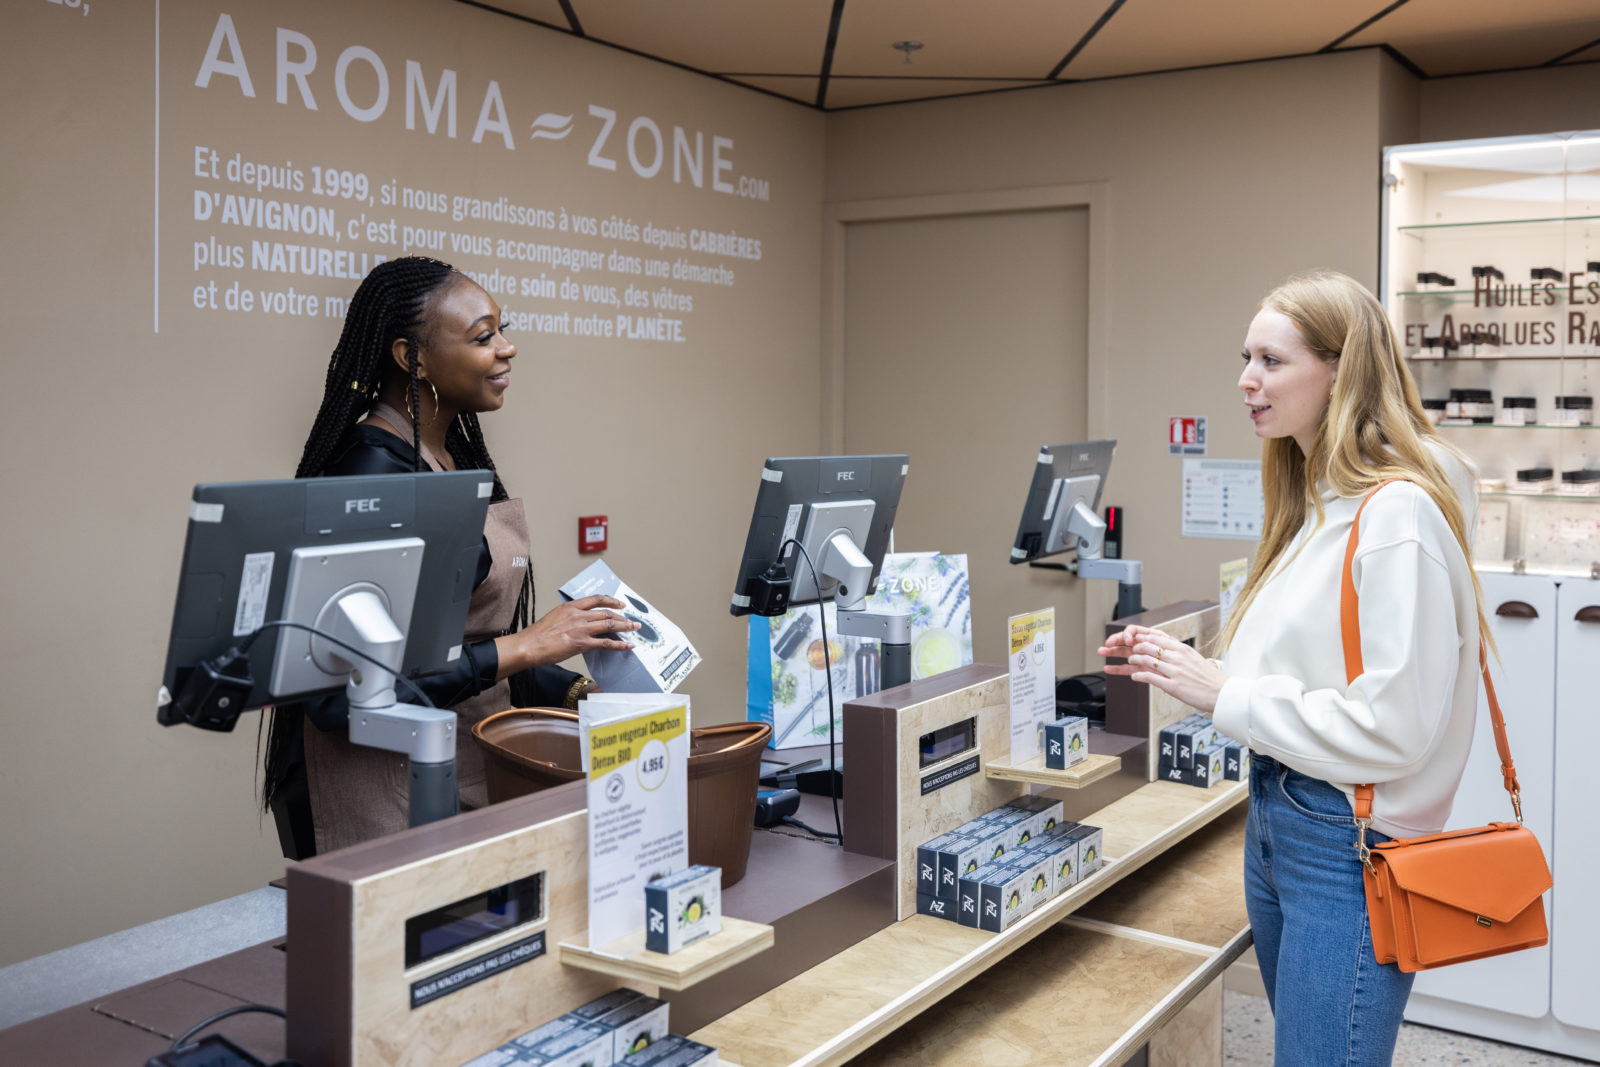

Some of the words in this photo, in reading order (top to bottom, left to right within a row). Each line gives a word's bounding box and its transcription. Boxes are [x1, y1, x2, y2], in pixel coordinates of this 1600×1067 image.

[195, 13, 516, 150] AROMA
[195, 146, 220, 179] Et
[227, 153, 304, 192] depuis
[312, 166, 374, 207] 1999,
[381, 179, 397, 206] si
[403, 187, 448, 214] nous
[452, 195, 555, 230] grandissons
[559, 206, 568, 231] à
[572, 215, 597, 236] vos
[601, 215, 640, 243] côtés
[643, 221, 687, 251] depuis
[690, 230, 762, 260] CABRIÈRES
[194, 190, 341, 243] D'AVIGNON,
[348, 212, 397, 245] c'est
[403, 225, 446, 252] pour
[451, 231, 492, 256] vous
[497, 238, 604, 272] accompagner
[608, 248, 642, 275] dans
[645, 258, 670, 278] une
[673, 257, 735, 286] démarche
[194, 235, 245, 271] plus
[521, 272, 556, 298] soin
[560, 275, 579, 301] de
[583, 283, 621, 309] vous,
[625, 283, 648, 307] des
[652, 287, 693, 312] vôtres
[193, 280, 218, 309] et
[225, 281, 254, 312] de
[260, 287, 318, 317] votre
[574, 313, 613, 337] notre
[616, 312, 686, 342] PLANÈTE.
[1406, 324, 1429, 347] ET
[1440, 314, 1555, 348] ABSOLUES
[837, 470, 855, 481] FEC
[345, 498, 381, 514] FEC
[890, 577, 937, 593] ZONE
[592, 735, 617, 750] Savon
[649, 717, 681, 735] Charbon
[617, 747, 632, 764] BIO
[929, 900, 945, 914] AZ
[414, 982, 437, 999] NOUS
[485, 957, 499, 969] PAS
[499, 953, 511, 965] LES
